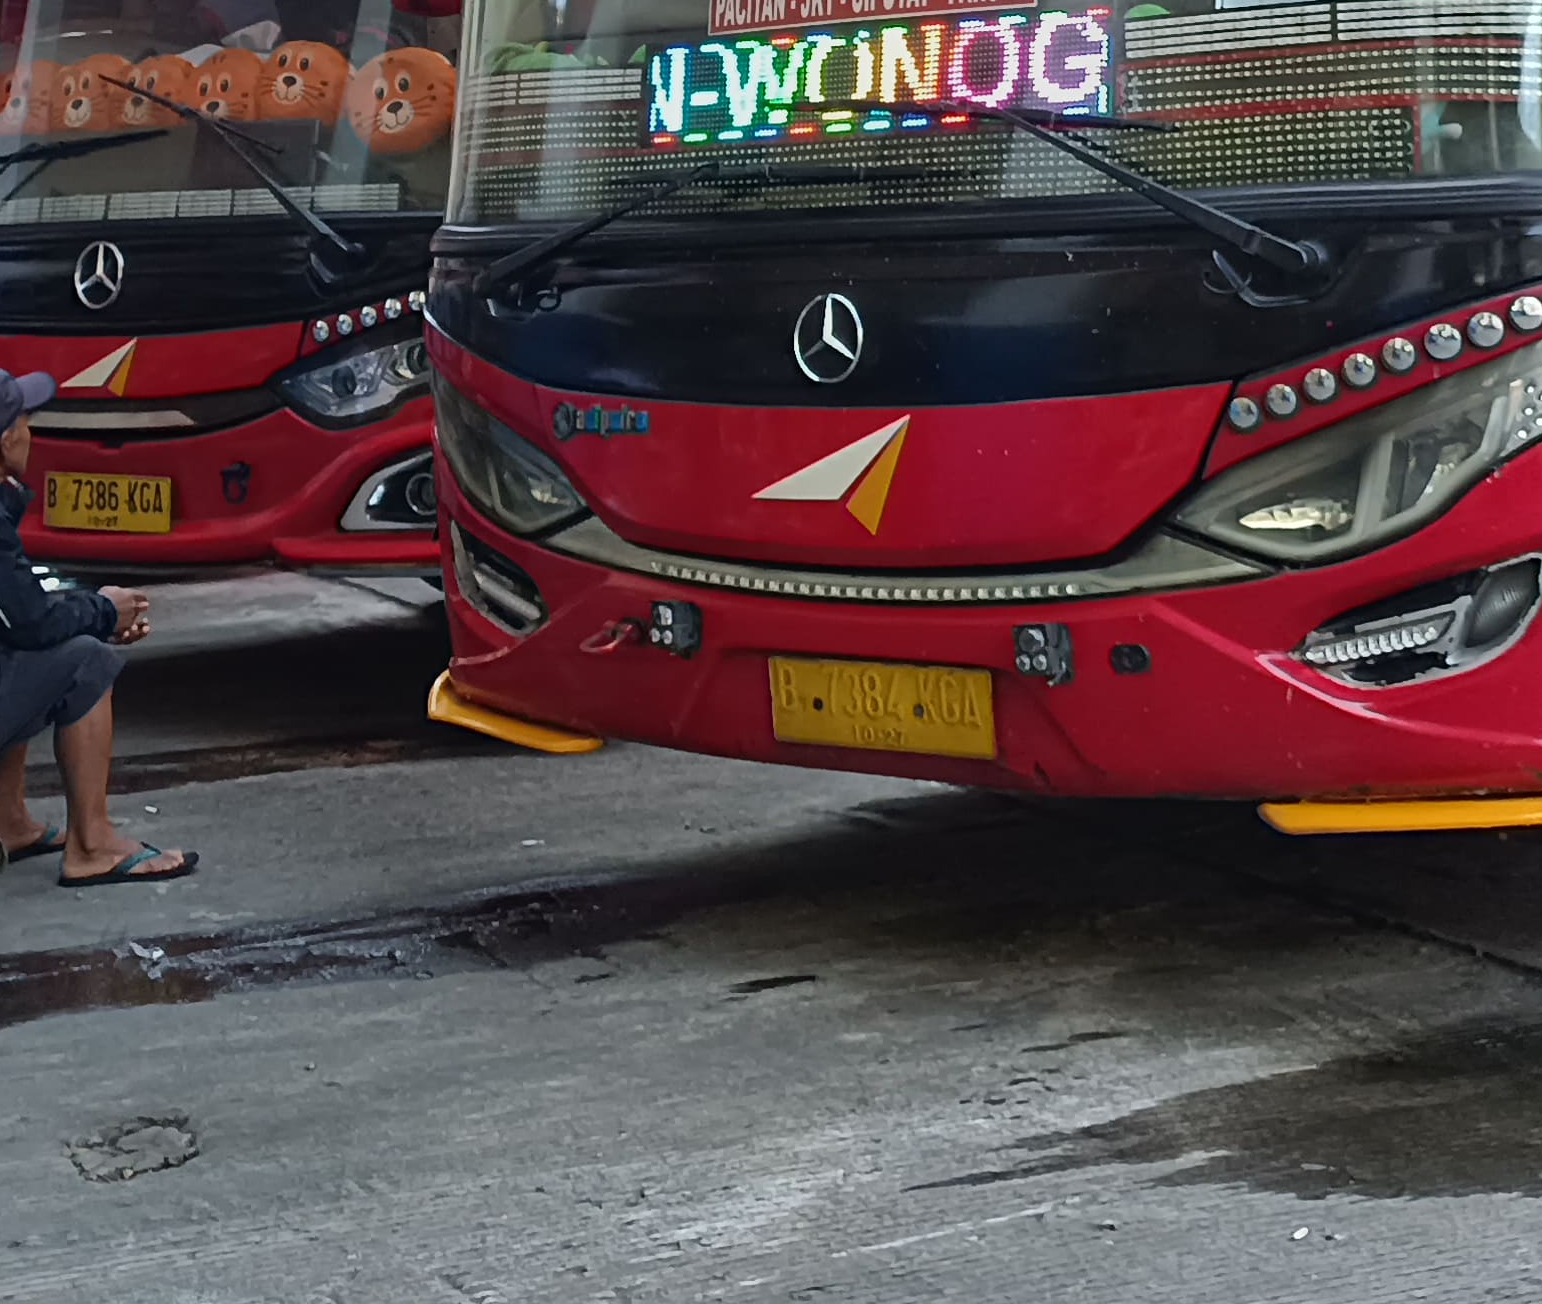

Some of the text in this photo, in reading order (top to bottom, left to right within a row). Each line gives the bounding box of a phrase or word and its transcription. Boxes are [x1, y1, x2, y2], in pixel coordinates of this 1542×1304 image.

[47, 478, 164, 514] B 7386 KGA
[778, 664, 982, 727] B 7384 KGA
